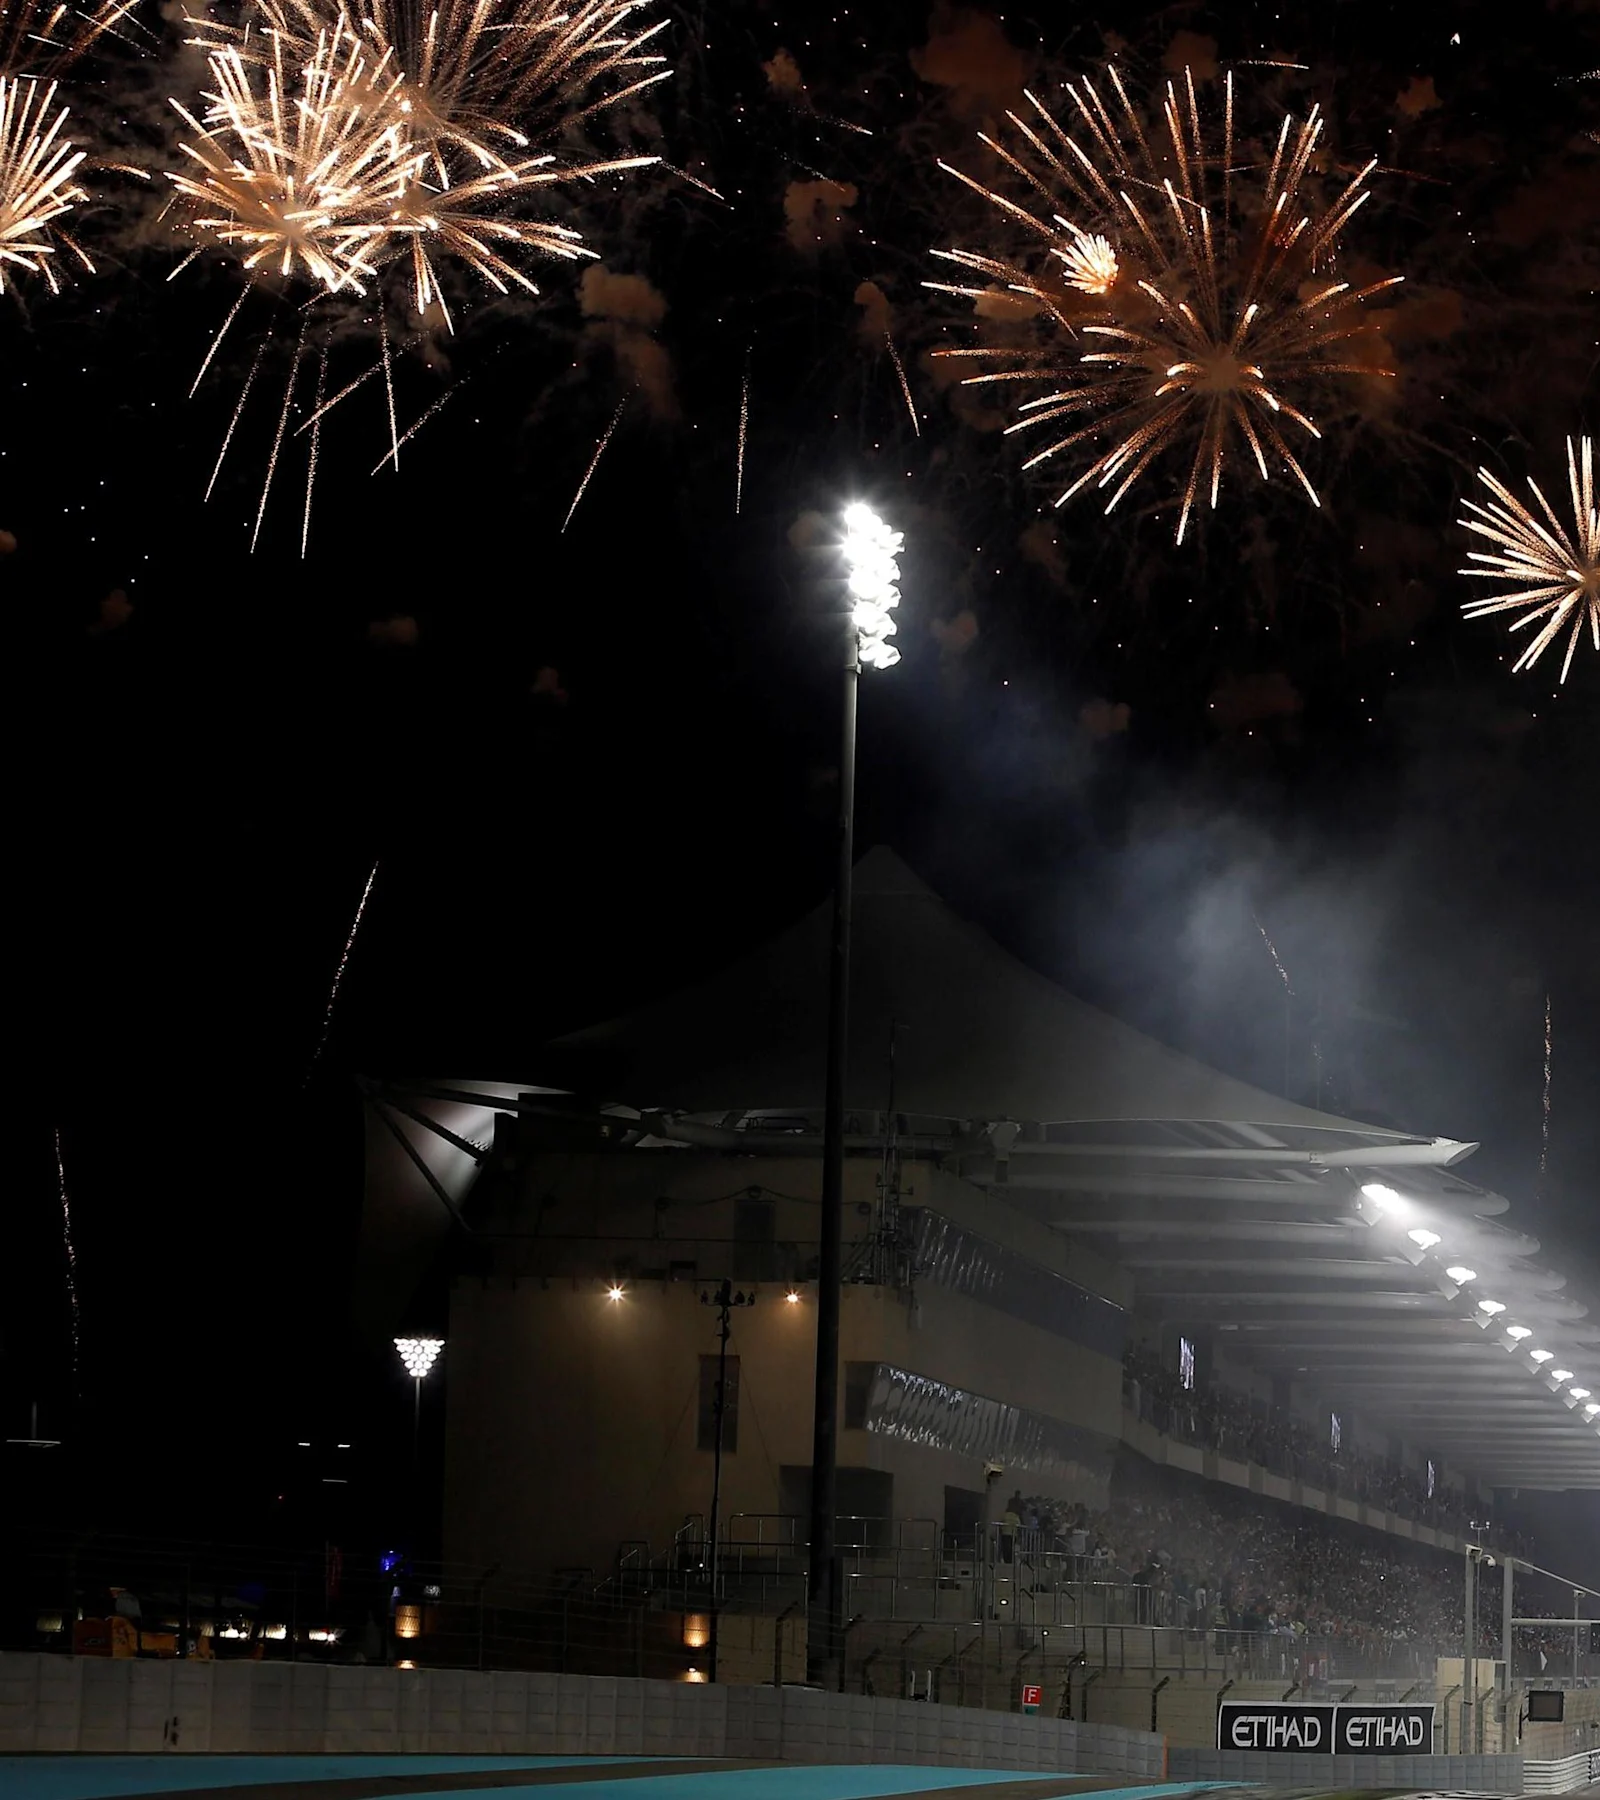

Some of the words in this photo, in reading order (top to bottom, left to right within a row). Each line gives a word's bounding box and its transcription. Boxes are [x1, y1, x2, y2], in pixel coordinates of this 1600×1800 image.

[1028, 1689, 1037, 1702] F
[1231, 1715, 1321, 1747] ETIHAD
[1346, 1716, 1424, 1747] ETIHAD
